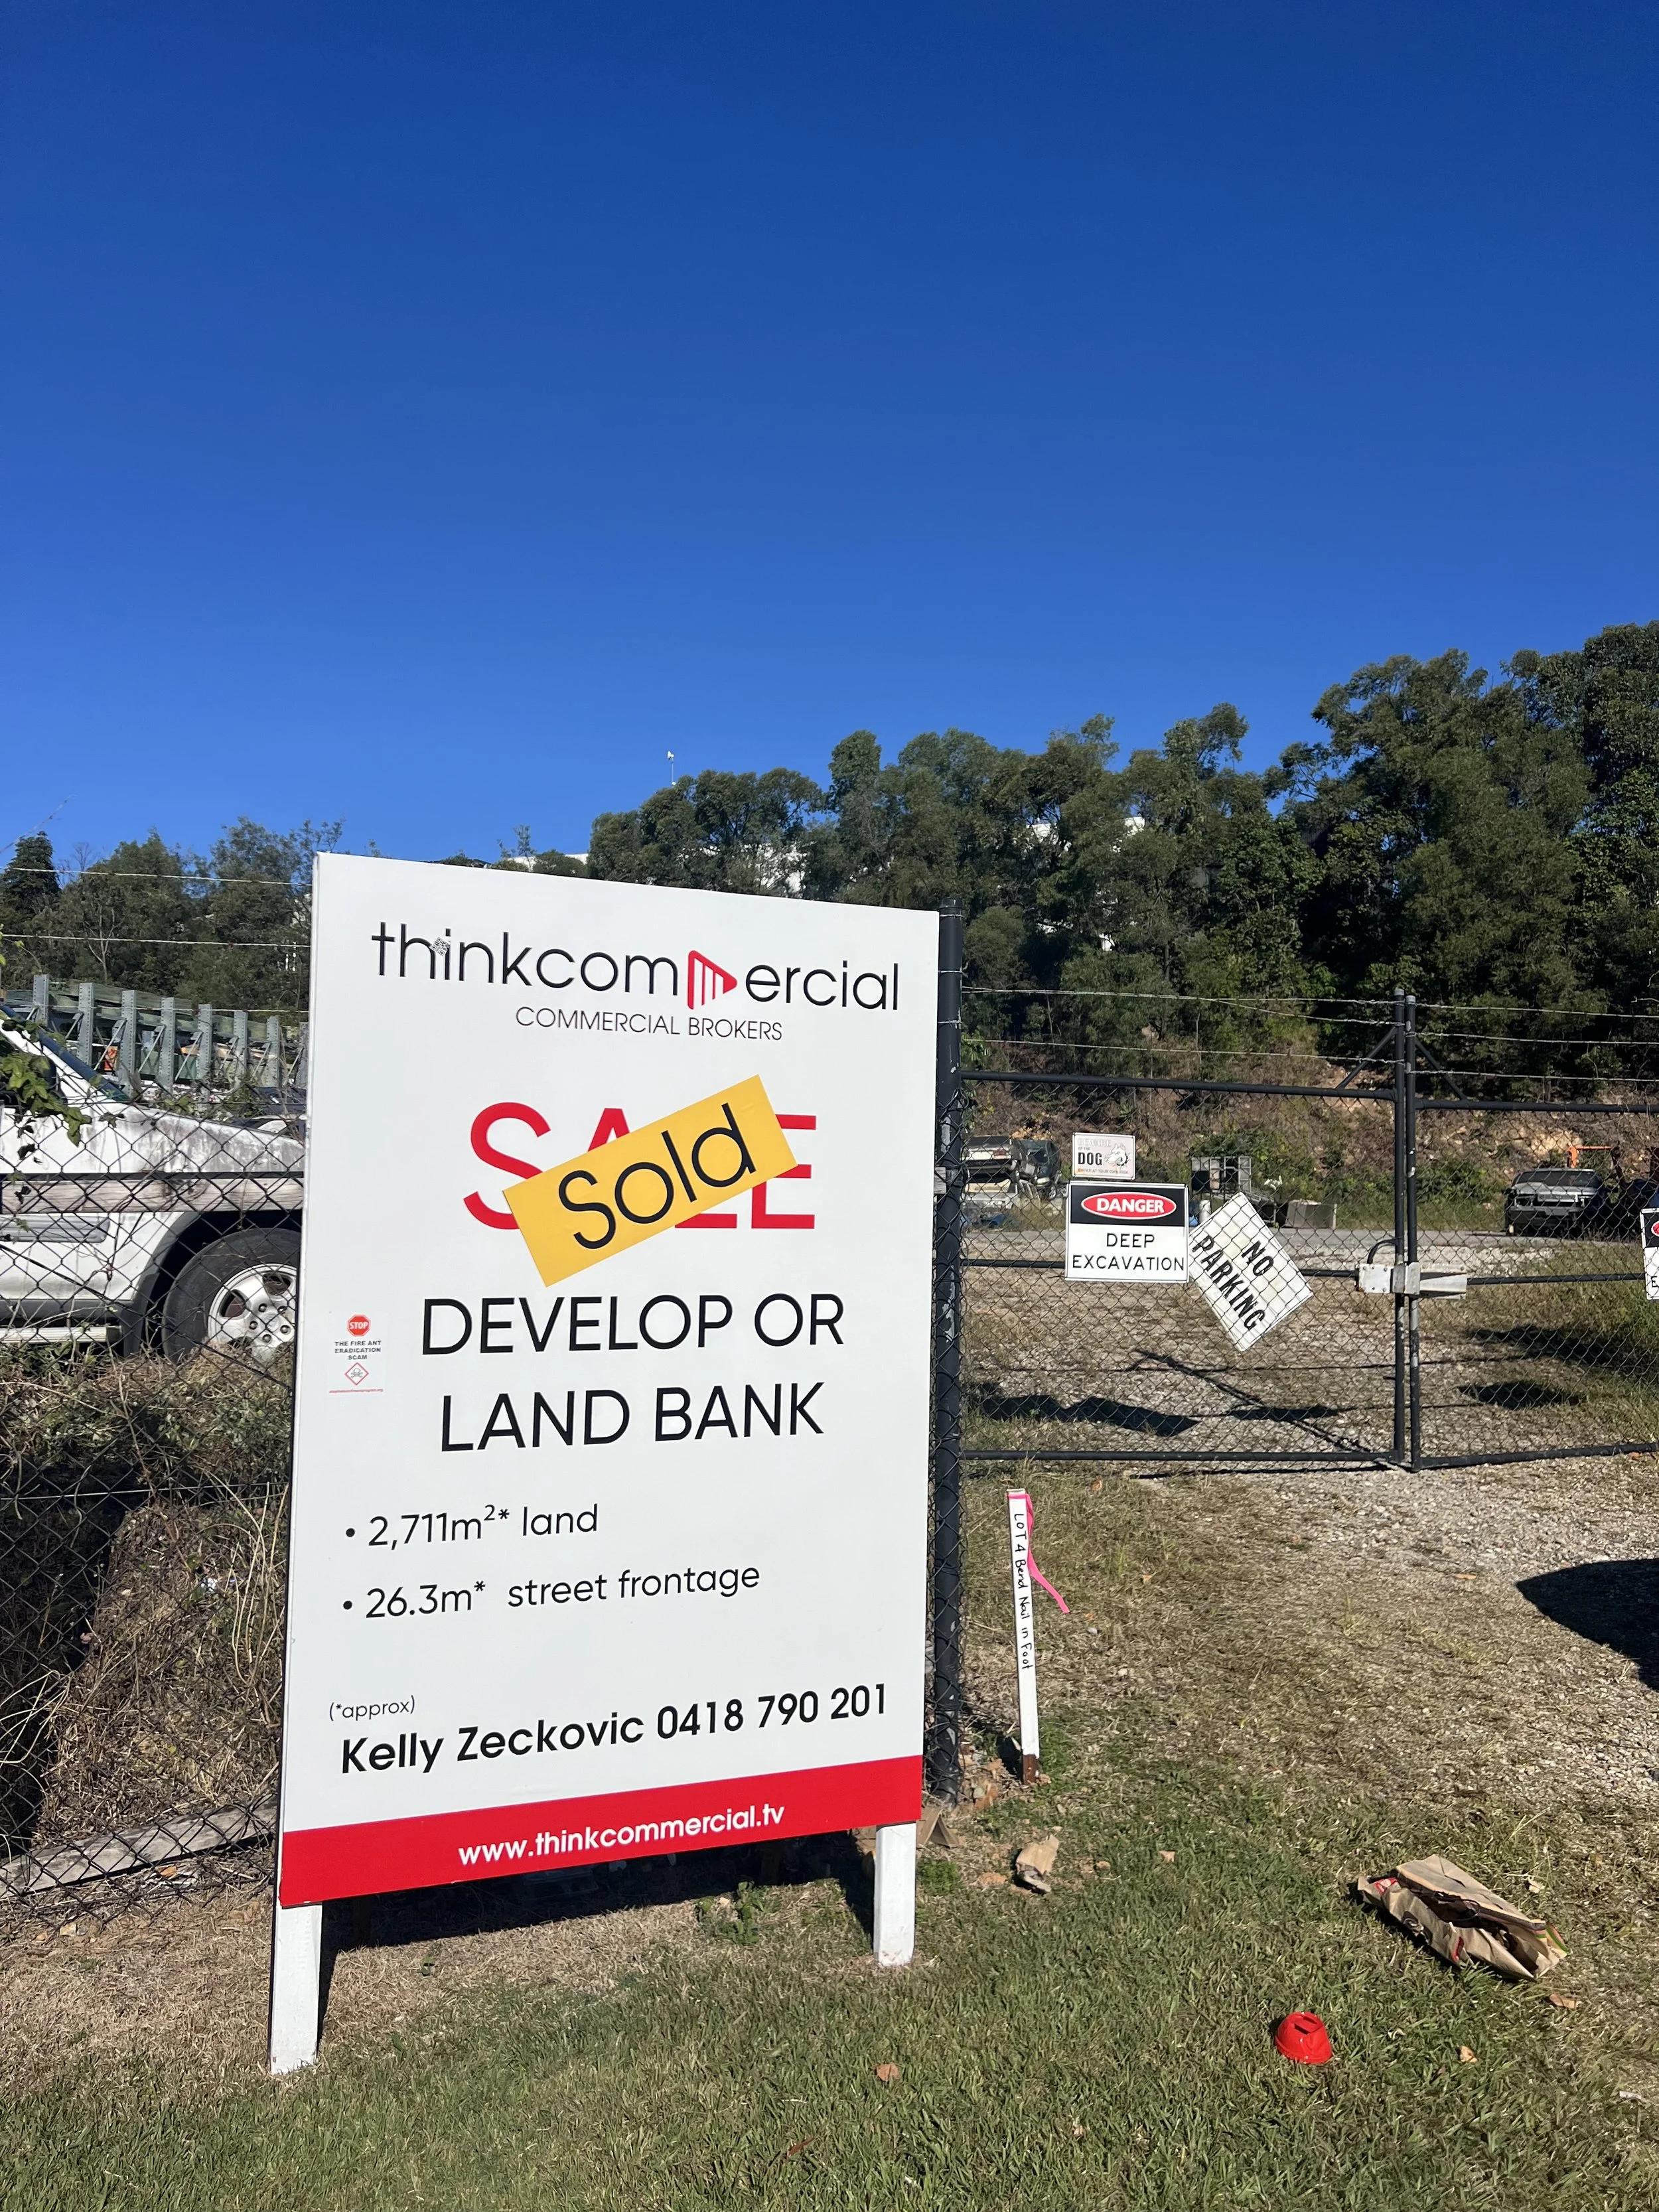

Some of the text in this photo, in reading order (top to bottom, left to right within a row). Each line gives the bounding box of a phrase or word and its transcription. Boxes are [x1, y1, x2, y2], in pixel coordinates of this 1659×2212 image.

[516, 1006, 782, 1041] COMMERCIAL BROKERS
[1078, 1138, 1112, 1147] BEWARE
[1078, 1152, 1102, 1166] DOG
[558, 1102, 757, 1250] Sold
[1096, 1197, 1165, 1214] DANGER
[1106, 1232, 1155, 1248] DEEP
[1072, 1254, 1184, 1271] EXCAVATION
[1241, 1240, 1274, 1276] NO
[1192, 1234, 1265, 1331] PARKING
[422, 1293, 844, 1355] DEVELOP OR
[441, 1382, 824, 1452] LAND BANK
[523, 1503, 598, 1536] land
[1014, 1513, 1027, 1540] LOT
[1015, 1544, 1026, 1552] 4
[508, 1574, 607, 1607] street
[618, 1564, 760, 1599] frontage
[1015, 1559, 1029, 1589] Bend
[1019, 1596, 1030, 1619] Nail
[1021, 1627, 1029, 1639] in
[342, 1683, 887, 1774] Kelly Zeckovic 0418 790 201
[459, 1803, 784, 1866] www.thinkcommercial.tv
